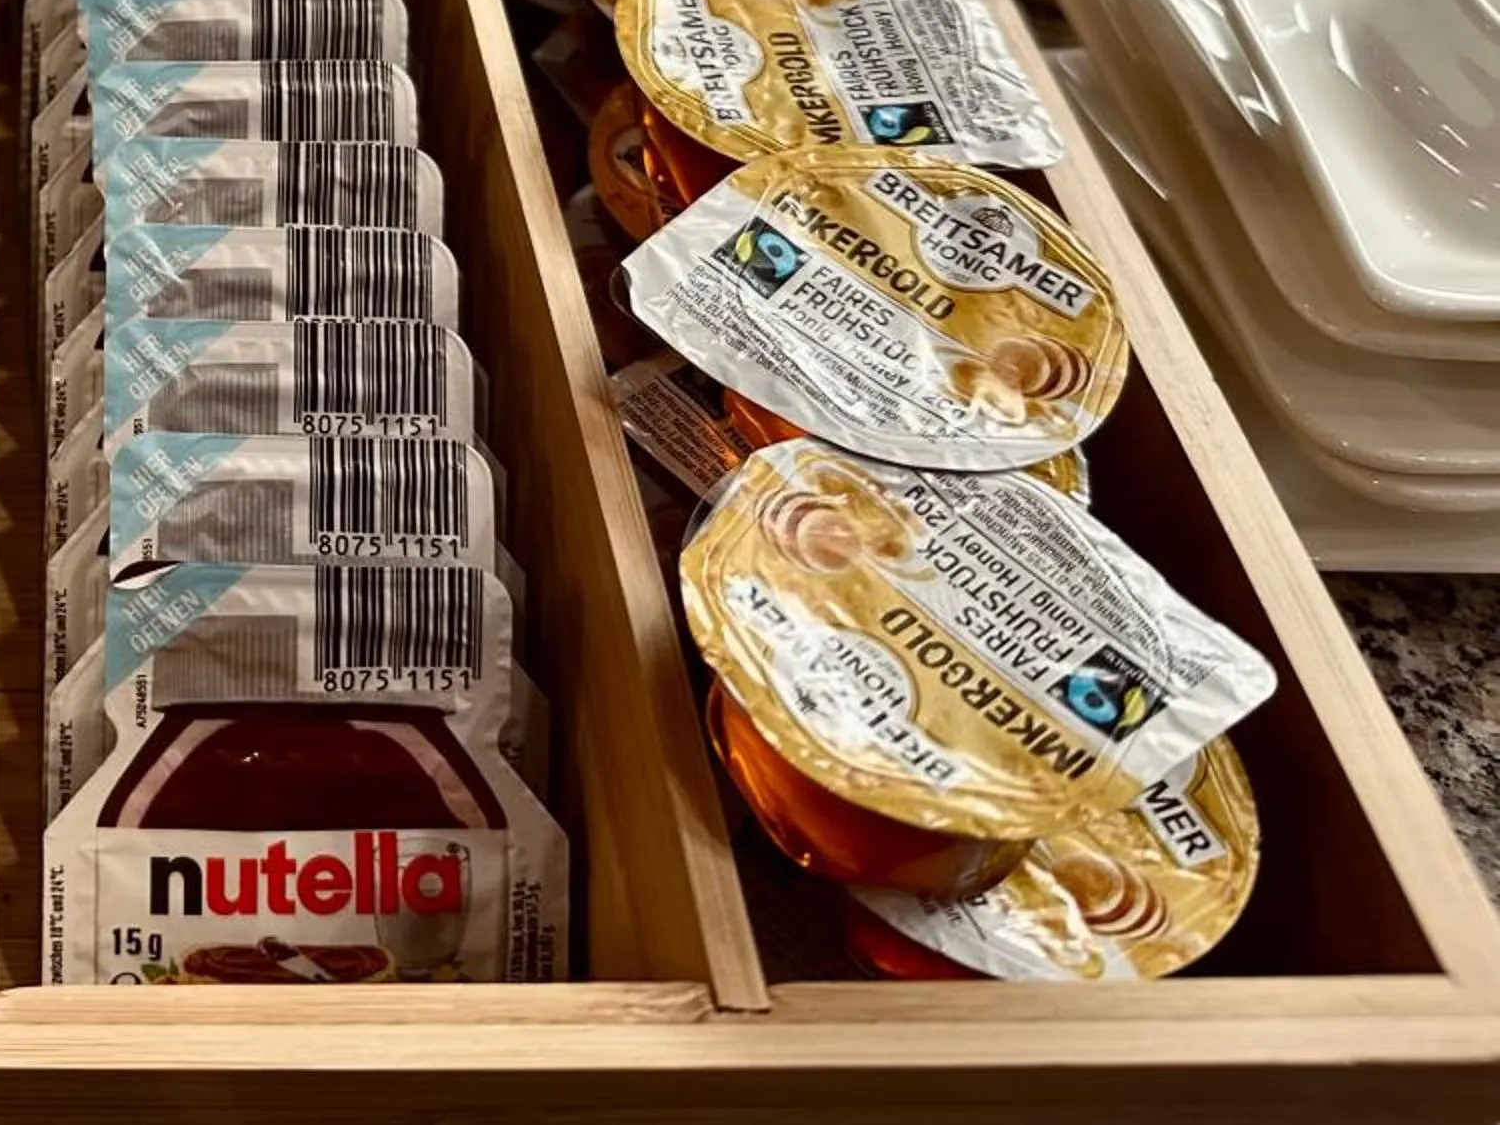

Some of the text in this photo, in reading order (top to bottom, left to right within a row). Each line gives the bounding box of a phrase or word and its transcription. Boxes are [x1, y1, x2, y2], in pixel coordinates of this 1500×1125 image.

[715, 25, 743, 73] ONIG
[838, 4, 901, 99] FRÜHSTÜCK
[872, 9, 905, 50] Honey
[836, 50, 873, 101] FAIRES
[897, 57, 929, 95] Honig
[873, 170, 1083, 309] BREITSAMER
[920, 232, 1001, 283] HONIG
[776, 298, 837, 343] Honig
[790, 280, 925, 373] FRÜHSTÜC
[809, 265, 896, 328] FAIRES
[302, 413, 438, 436] 8075 1151
[318, 534, 460, 559] 8075 1151
[897, 484, 1100, 646] Honig Honey 20g
[910, 538, 1076, 666] FRÜHSTÜCK
[814, 634, 910, 708] HONIG
[952, 605, 1051, 681] FAIRES
[322, 668, 474, 693] 8075 1151
[871, 606, 1098, 781] IMKERGOLD
[149, 831, 463, 916] nutella
